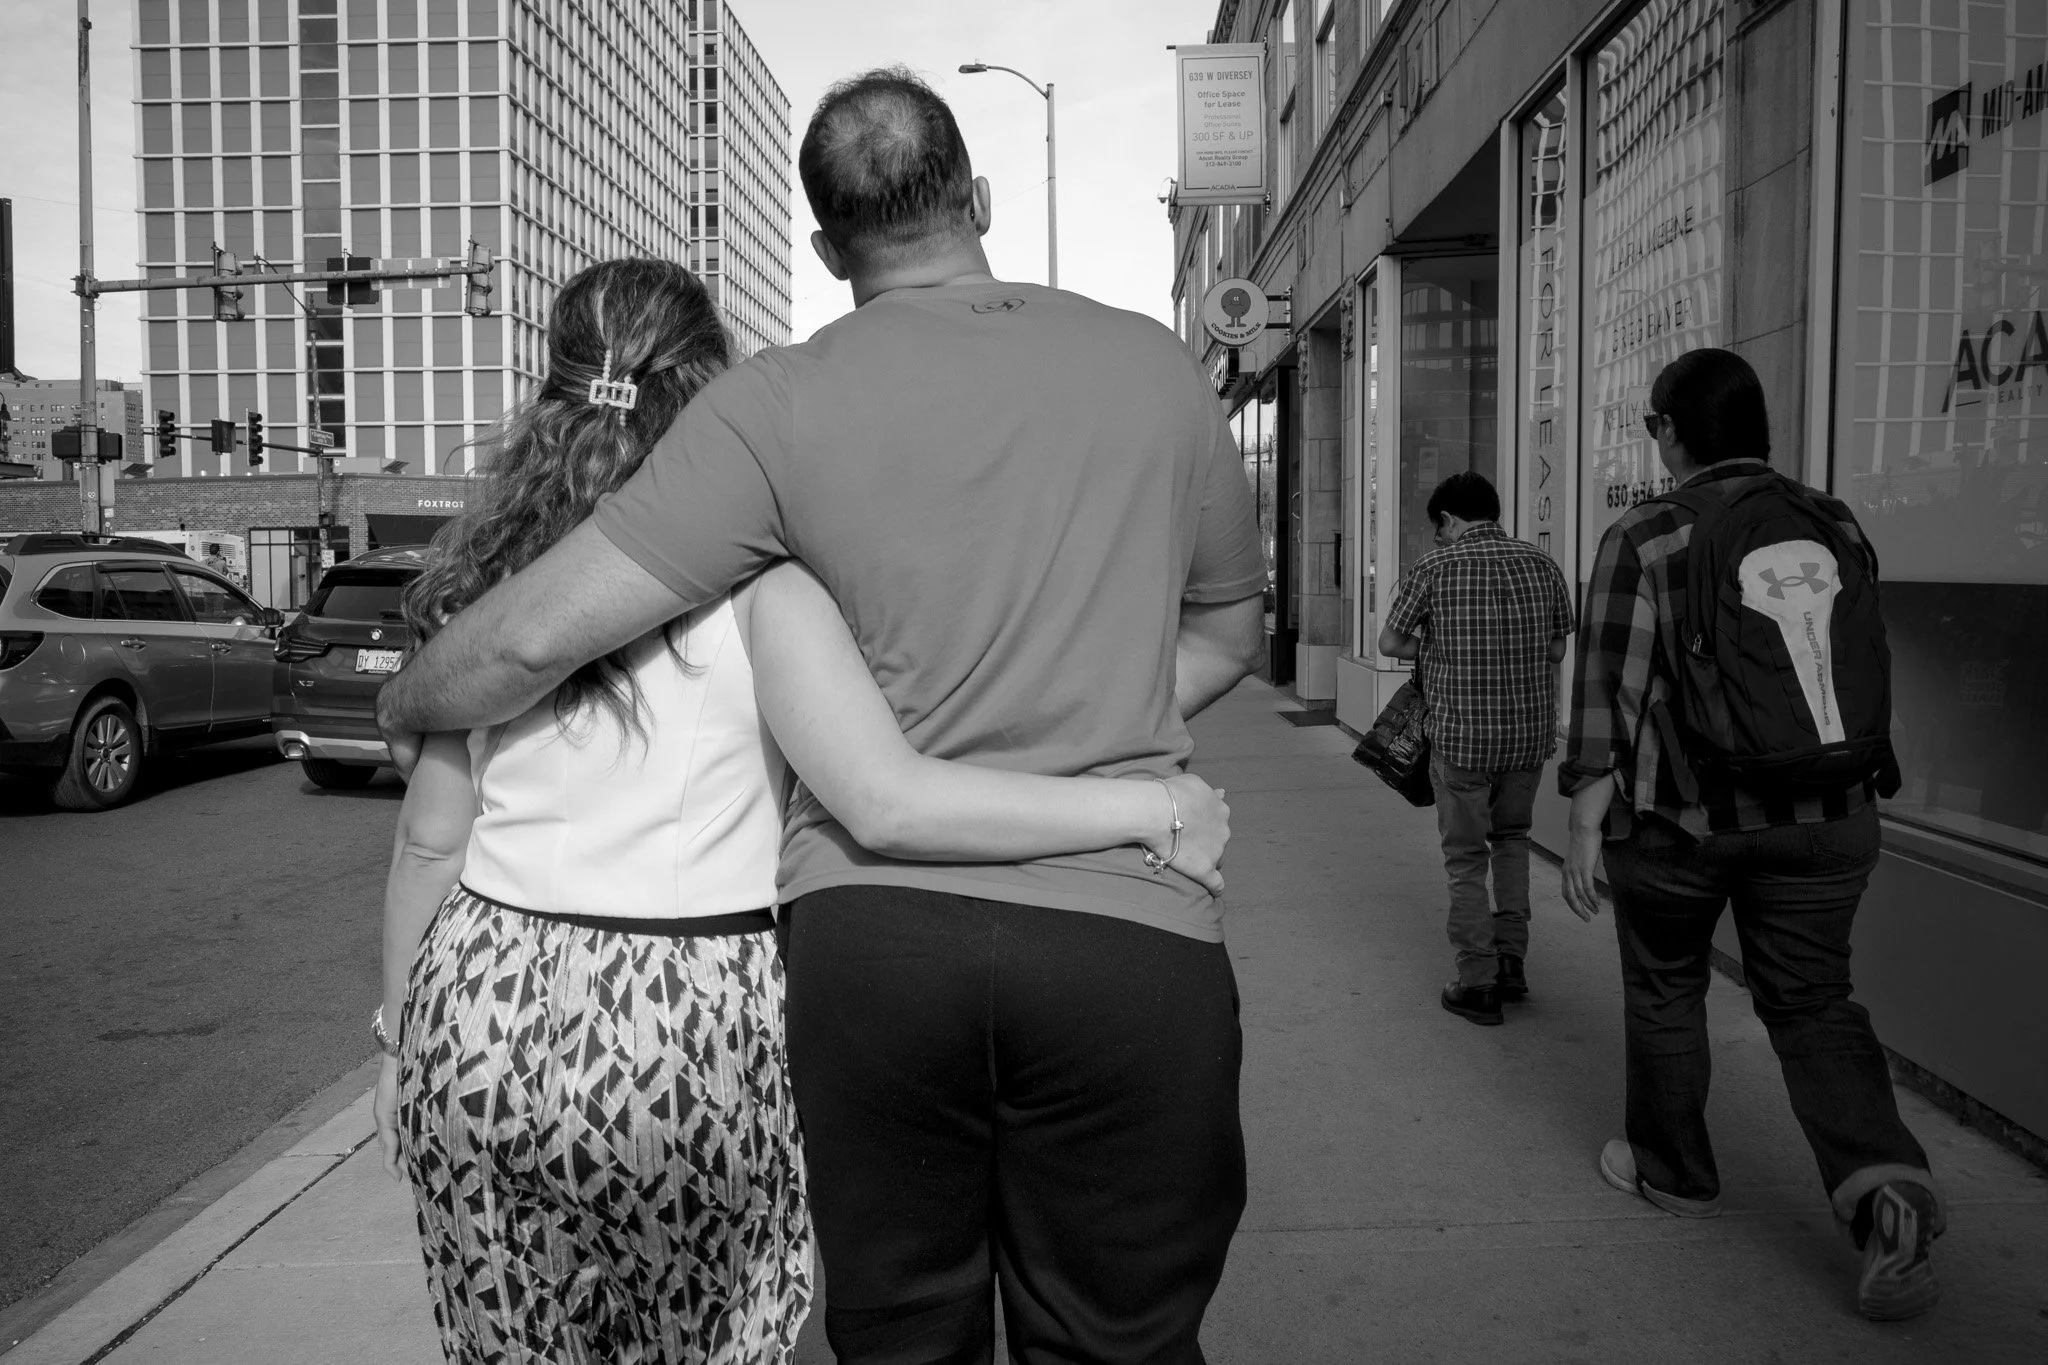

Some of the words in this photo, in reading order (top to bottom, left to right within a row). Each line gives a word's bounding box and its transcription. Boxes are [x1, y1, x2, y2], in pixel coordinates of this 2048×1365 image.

[1189, 72, 1204, 81] 639
[1206, 71, 1214, 81] W
[1217, 70, 1253, 80] DIVERSEY
[1221, 90, 1246, 99] Space
[1217, 100, 1241, 108] Lease
[1192, 131, 1210, 142] 300
[1212, 131, 1226, 141] SF
[1228, 130, 1236, 141] &
[1239, 130, 1254, 140] UP
[1210, 183, 1237, 191] ACADIA
[1540, 246, 1554, 362] FOR
[1211, 323, 1239, 338] COOKIES
[1246, 322, 1261, 336] MILK
[1538, 384, 1553, 549] LEASE
[417, 499, 465, 508] FOXTROT
[1803, 611, 1822, 660] UNDER
[357, 655, 370, 669] DY
